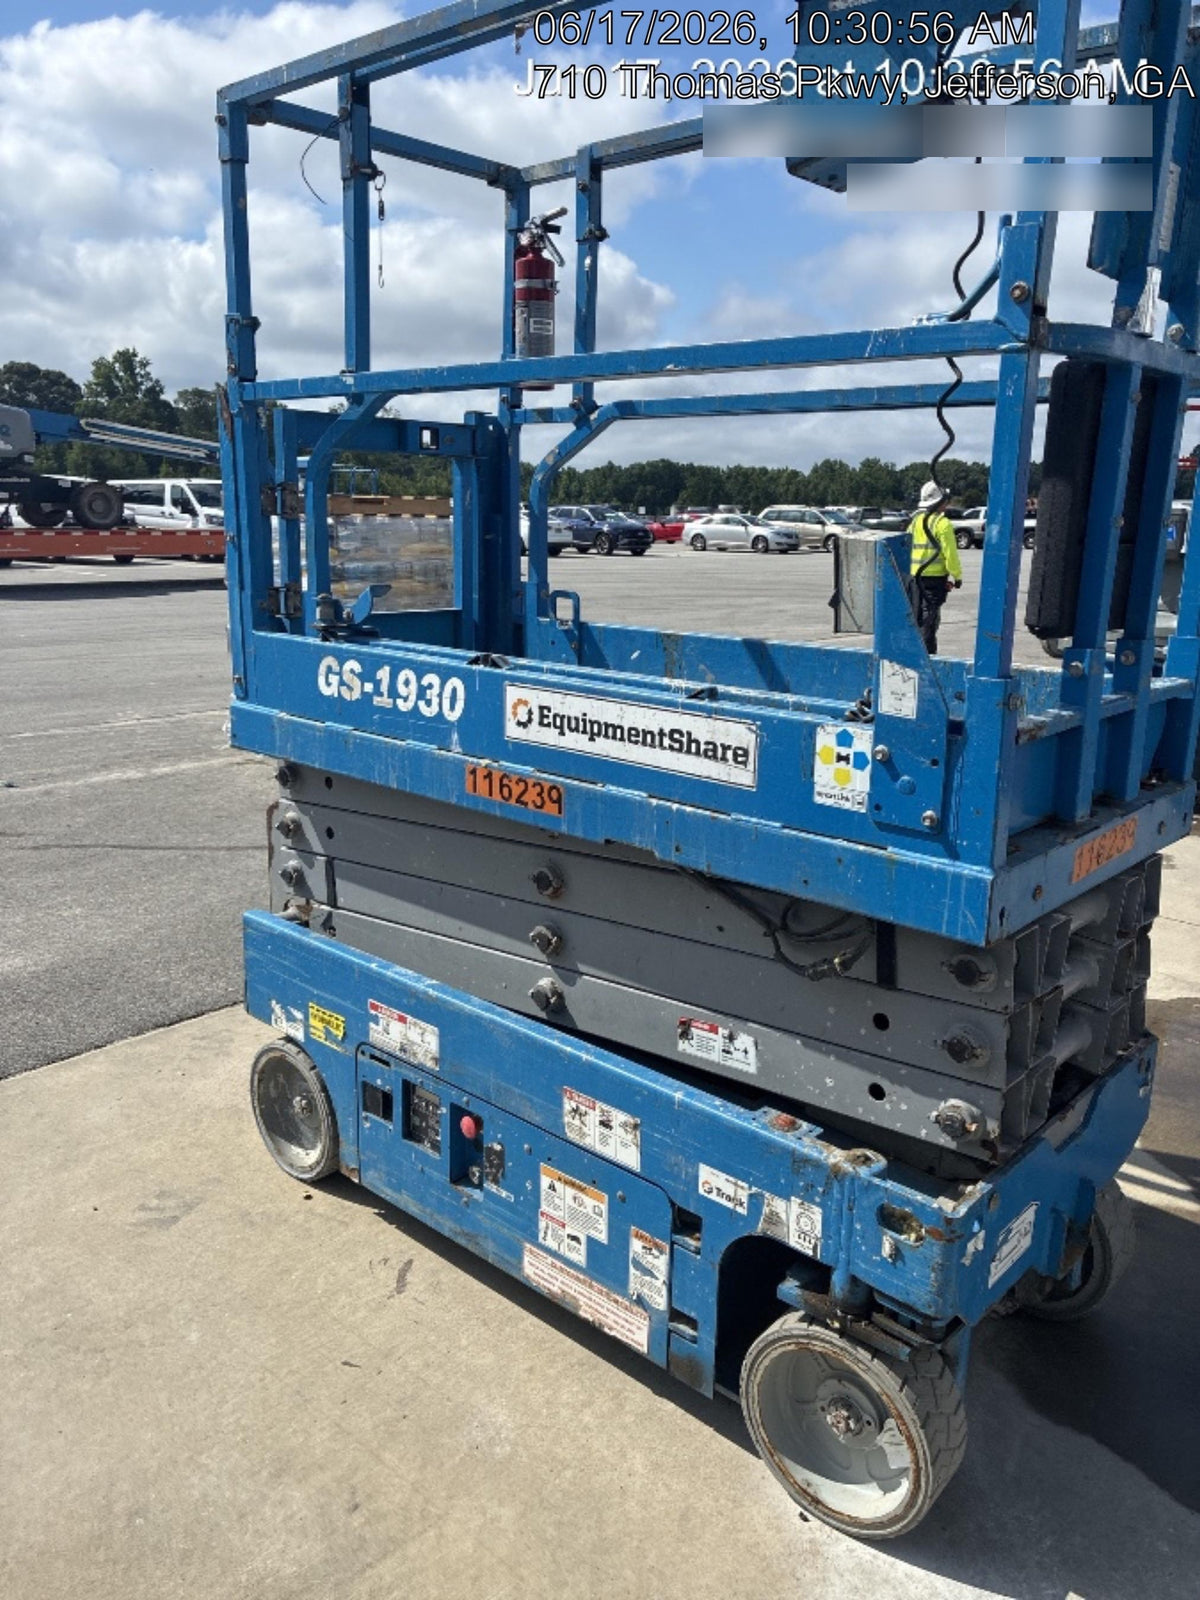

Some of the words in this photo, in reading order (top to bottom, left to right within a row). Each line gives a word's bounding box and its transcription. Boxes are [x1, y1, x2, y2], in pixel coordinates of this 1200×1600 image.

[317, 655, 466, 722] GS-1930
[537, 704, 751, 768] EquipmentShare
[467, 766, 564, 817] 116239
